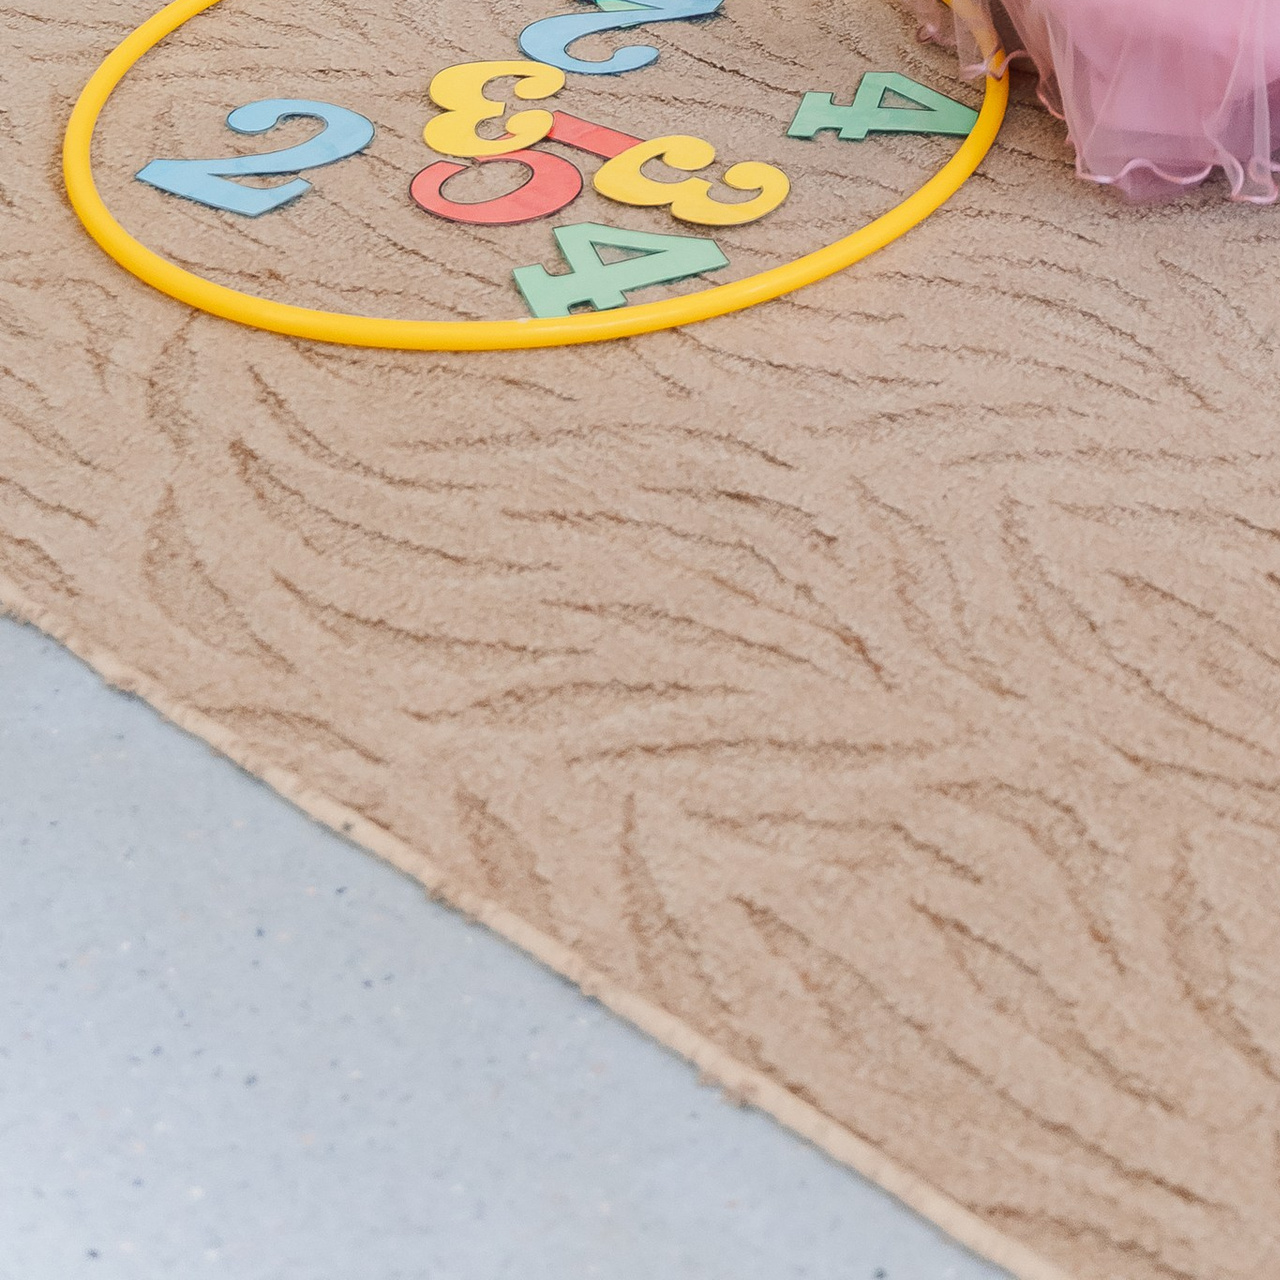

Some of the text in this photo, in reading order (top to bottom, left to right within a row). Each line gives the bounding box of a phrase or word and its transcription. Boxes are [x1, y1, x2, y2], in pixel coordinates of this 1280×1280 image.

[423, 60, 566, 158] 3
[787, 71, 980, 140] 4
[135, 98, 376, 218] 2
[593, 134, 791, 226] 3
[512, 221, 730, 318] 4
